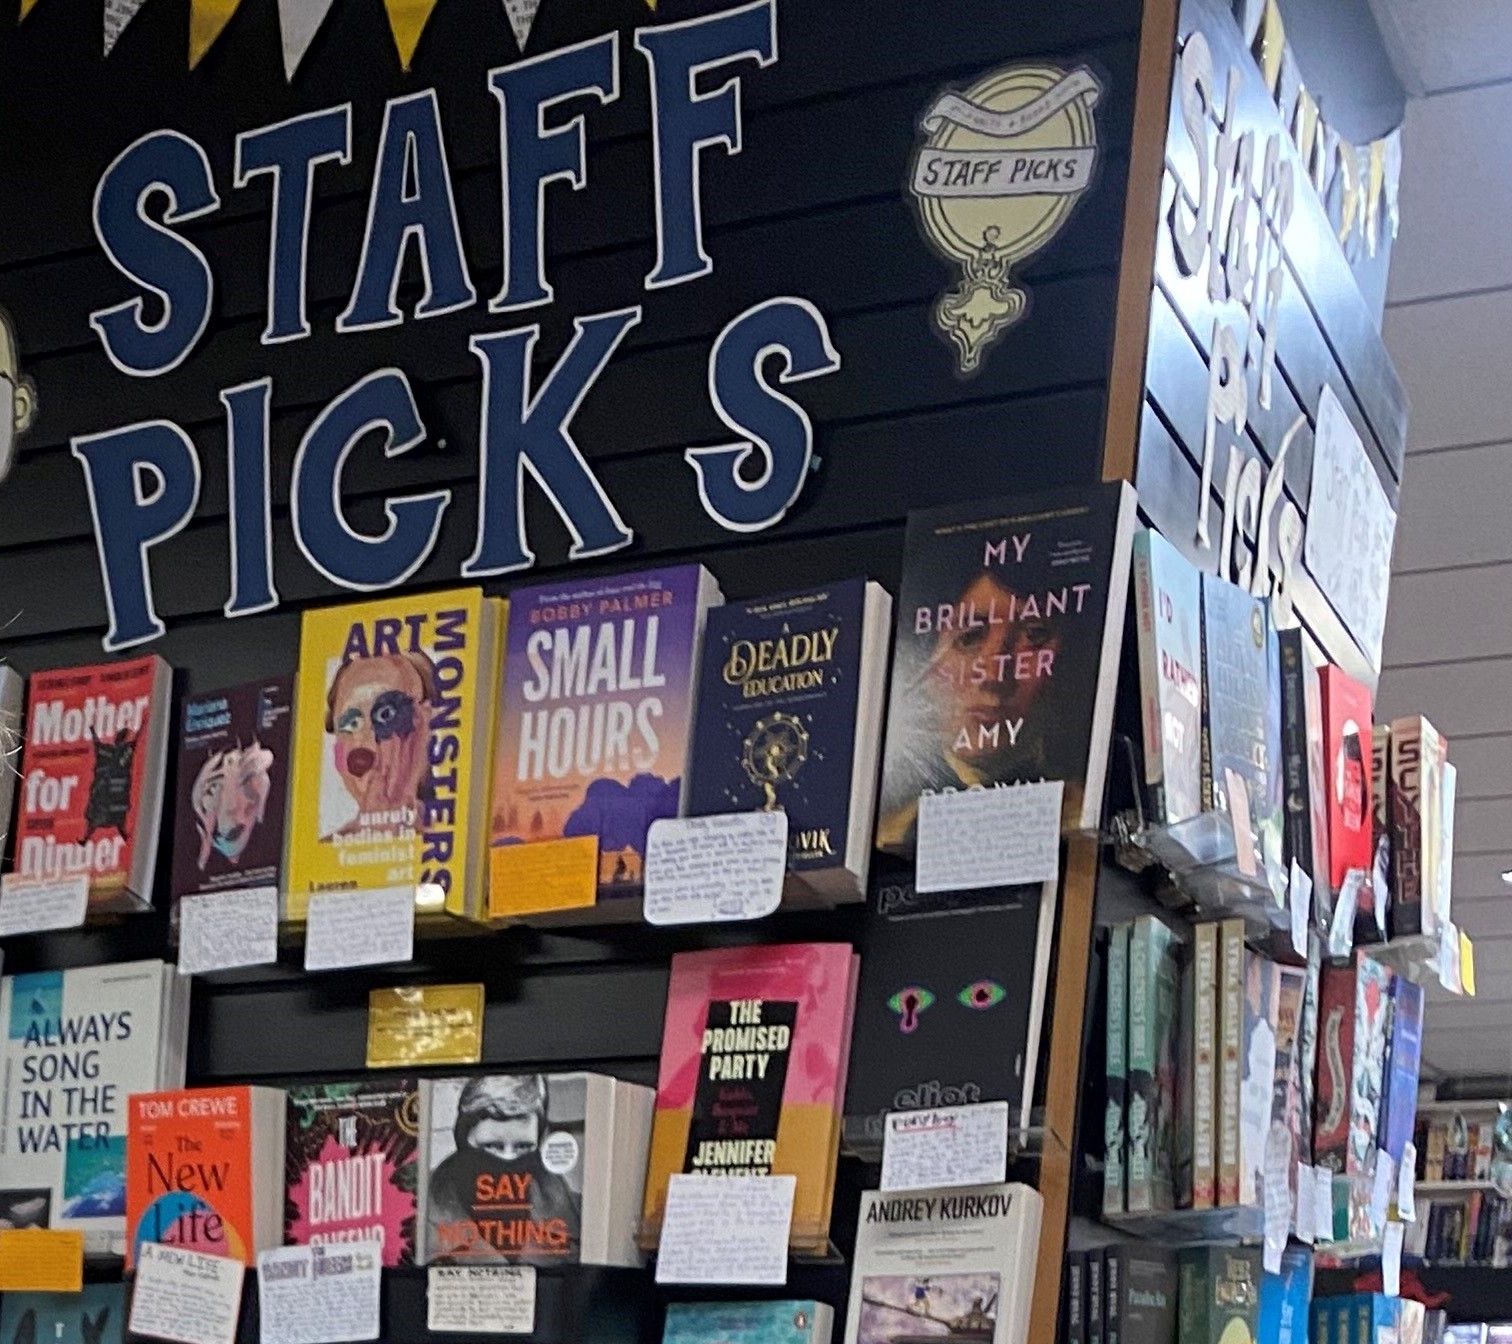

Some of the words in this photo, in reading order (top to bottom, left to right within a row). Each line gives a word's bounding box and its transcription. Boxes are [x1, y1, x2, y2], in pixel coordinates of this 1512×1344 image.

[90, 0, 778, 377] STAFF
[922, 157, 1002, 187] STAFF
[1009, 157, 1078, 184] PICKS
[71, 296, 841, 652] PICKS
[983, 532, 1032, 567] MY
[530, 602, 593, 624] BOBBY
[599, 590, 673, 614] PALMER
[914, 583, 1092, 636] BRILLIANT
[342, 613, 429, 662] ART
[522, 614, 665, 701] SMALL
[723, 627, 839, 684] DEADLY
[934, 648, 1055, 686] SISTER
[743, 669, 824, 698] EDUCATION
[30, 694, 150, 746] Mother
[951, 717, 1024, 752] AMY
[420, 608, 469, 893] MONSTERS
[517, 697, 664, 781] HOURS
[24, 768, 78, 814] for
[359, 807, 418, 827] unruly
[19, 833, 127, 874] Dinner
[338, 847, 415, 866] feminist
[386, 864, 414, 882] art
[24, 1011, 131, 1048] ALWAYS
[728, 1000, 763, 1026] THE
[700, 1025, 790, 1054] PROMISED
[21, 1050, 100, 1084] SONG
[708, 1053, 770, 1081] PARTY
[19, 1089, 52, 1119] IN
[63, 1084, 116, 1116] THE
[138, 1100, 175, 1120] TOM
[177, 1096, 238, 1118] CREWE
[17, 1121, 112, 1153] WATER
[175, 1135, 202, 1154] The
[338, 1116, 358, 1147] THE
[692, 1139, 777, 1167] JENNIFER
[145, 1152, 231, 1195] New
[309, 1153, 386, 1225] BANDIT
[474, 1172, 533, 1202] SAY
[153, 1200, 225, 1246] Life
[866, 1195, 934, 1224] ANDREY
[939, 1193, 1013, 1220] KURKOV
[436, 1218, 570, 1247] NOTHING
